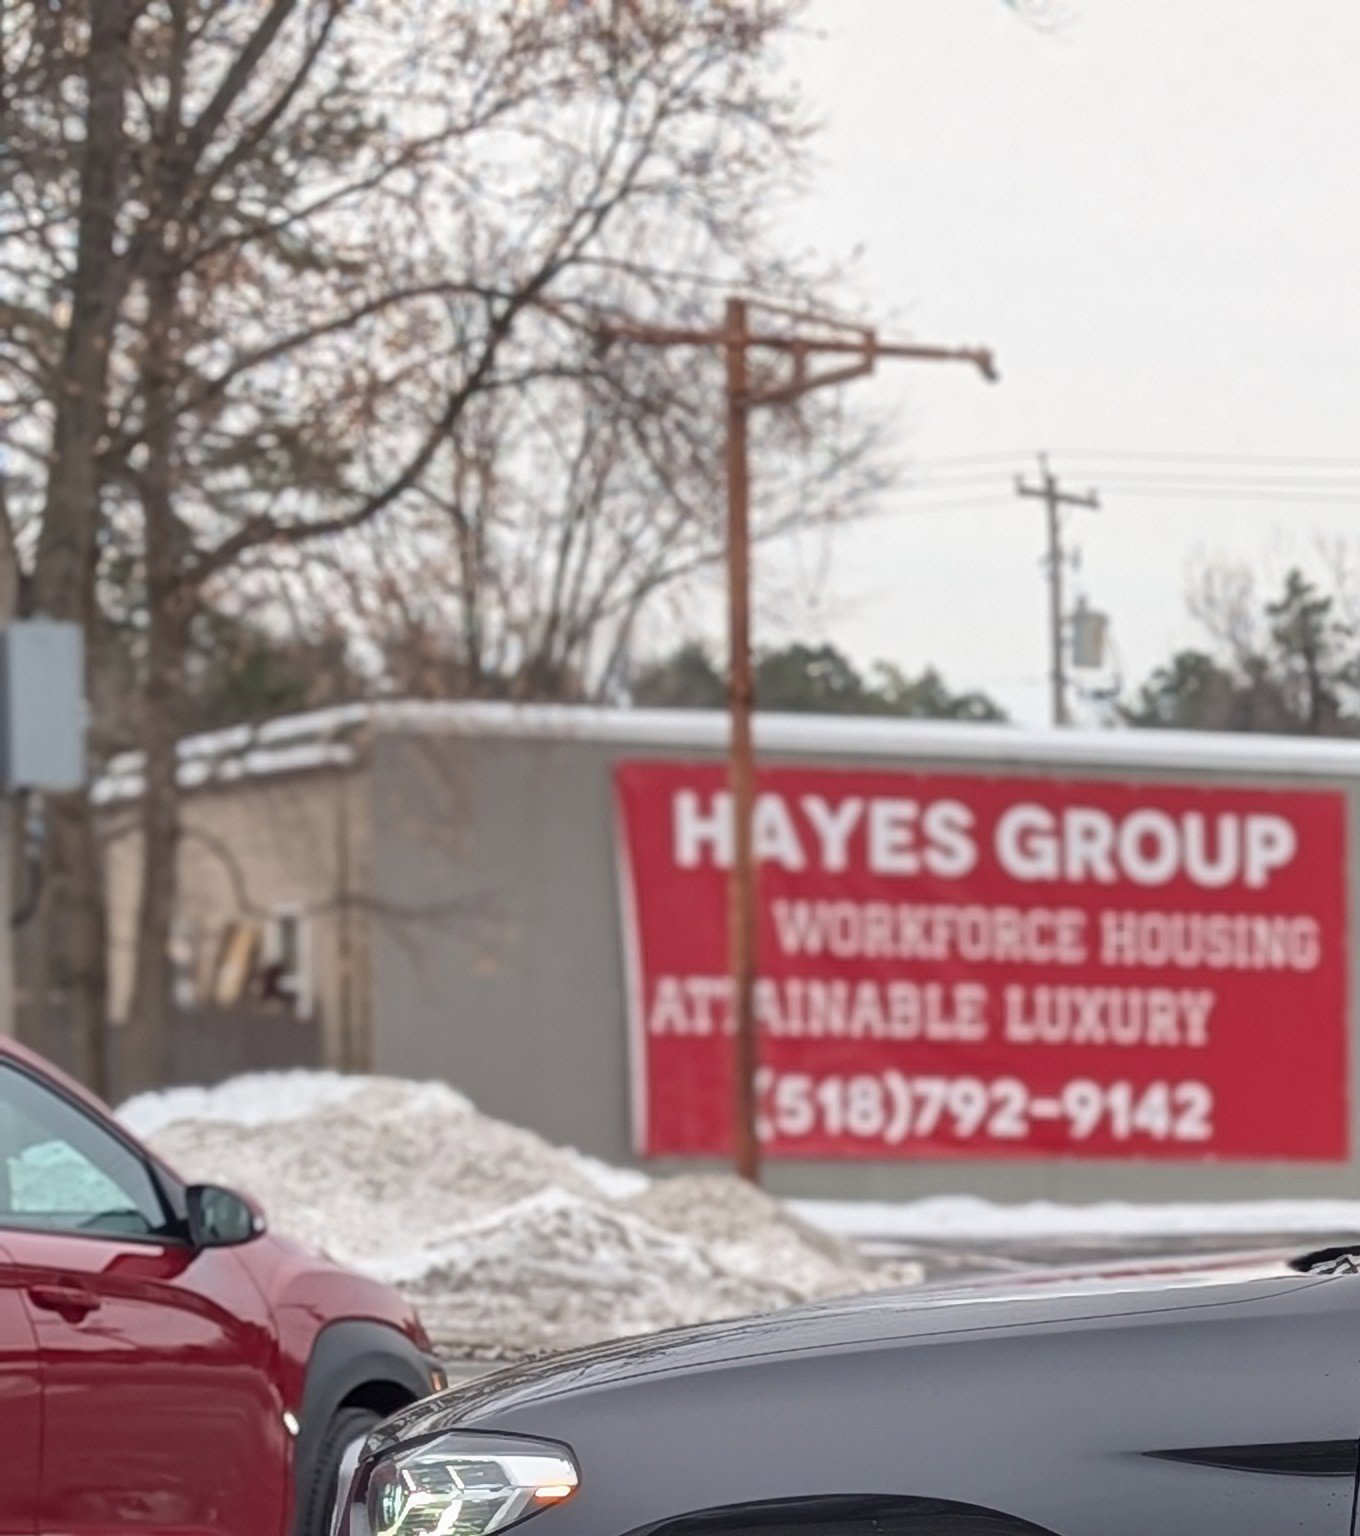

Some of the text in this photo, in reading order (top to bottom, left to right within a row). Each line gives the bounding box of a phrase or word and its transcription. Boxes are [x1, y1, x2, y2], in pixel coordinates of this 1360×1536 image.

[671, 790, 1298, 888] HAYES GROUP
[772, 898, 1321, 970] WORKFORCE HOUSING
[1004, 984, 1217, 1046] LUXURY
[754, 1066, 1213, 1142] (518)792-9142
